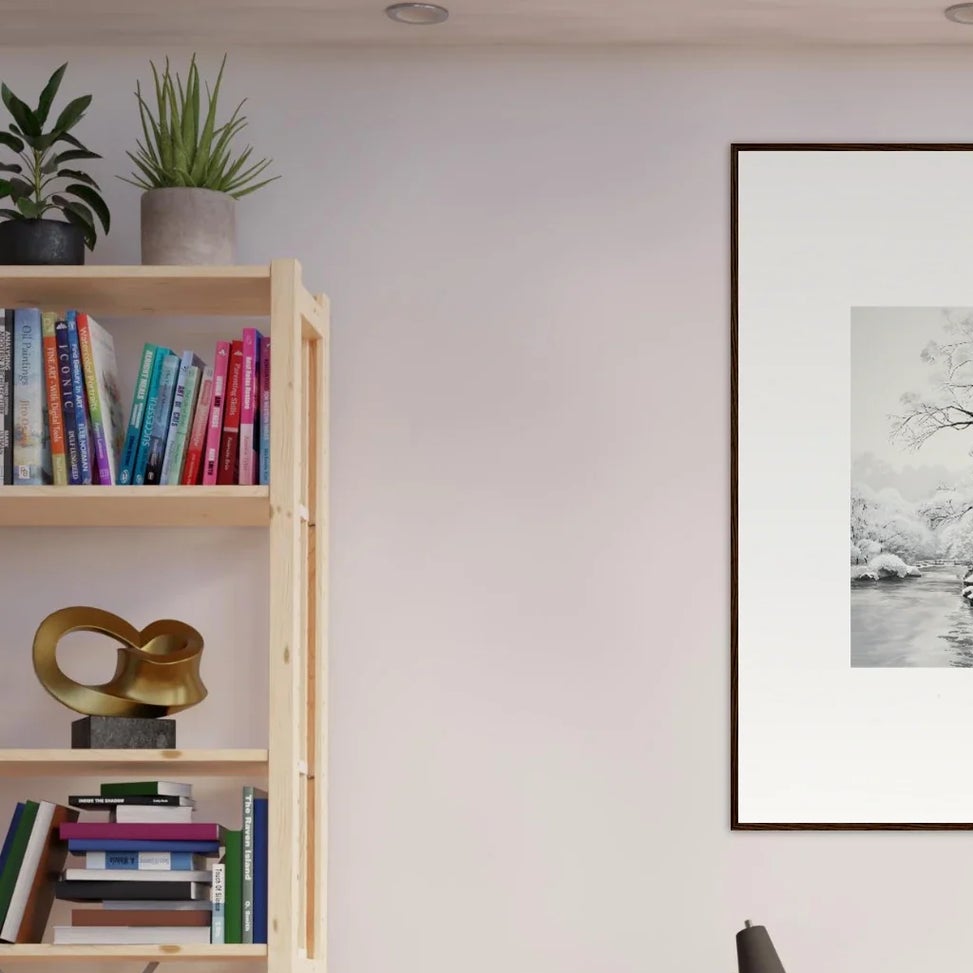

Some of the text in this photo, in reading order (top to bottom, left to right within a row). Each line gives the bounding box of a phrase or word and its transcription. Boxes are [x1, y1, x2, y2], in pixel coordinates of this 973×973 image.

[19, 325, 32, 386] Oil Paintings
[48, 347, 56, 363] FINE
[48, 364, 57, 379] ART
[59, 344, 74, 408] ICONIC
[72, 359, 80, 384] Beauty
[80, 326, 98, 411] Watercolor Portraits
[50, 385, 58, 401] With
[75, 395, 83, 408] ART
[229, 363, 241, 416] Parenting Skills
[49, 402, 60, 425] Digital
[142, 397, 157, 447] SUCCESSFUL
[53, 426, 62, 442] Tools
